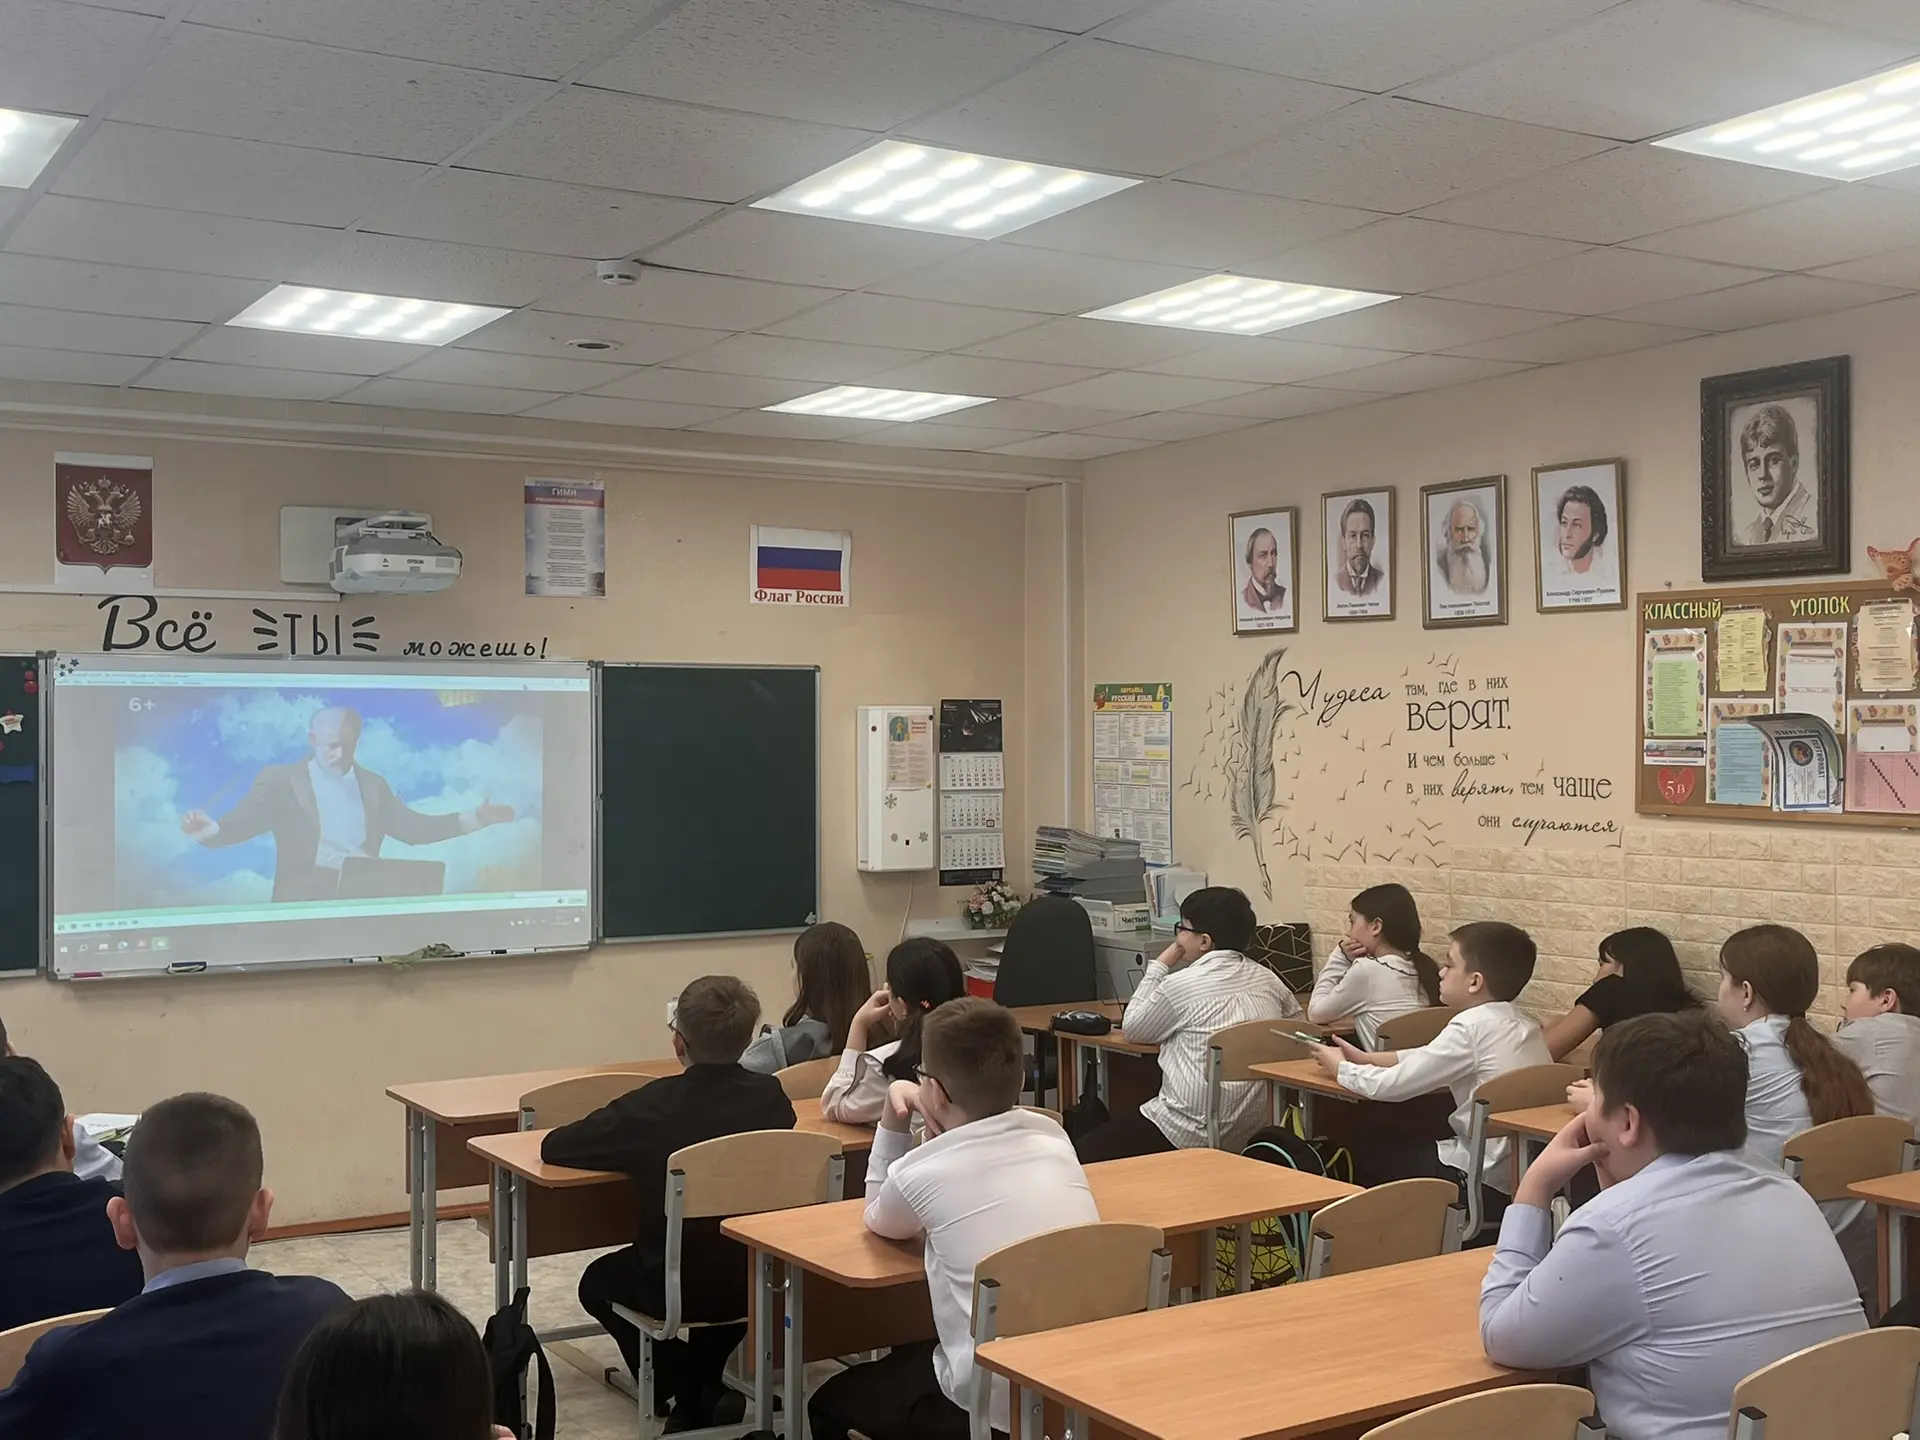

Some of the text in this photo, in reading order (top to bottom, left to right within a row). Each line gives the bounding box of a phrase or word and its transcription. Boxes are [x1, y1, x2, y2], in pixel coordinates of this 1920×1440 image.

[552, 487, 577, 497] ГИМН
[754, 588, 845, 605] Флаг России
[1789, 596, 1850, 617] УГОЛОК
[1644, 598, 1722, 620] КЛАССНЫЙ
[97, 594, 548, 660] Всё ТЫ можешь!
[128, 697, 157, 712] 6+
[1281, 669, 1509, 726] Чудеса там, где в них
[1407, 752, 1496, 768] И чем больше
[1406, 768, 1613, 804] в них верят, тем чаще
[1477, 815, 1618, 847] они случаются
